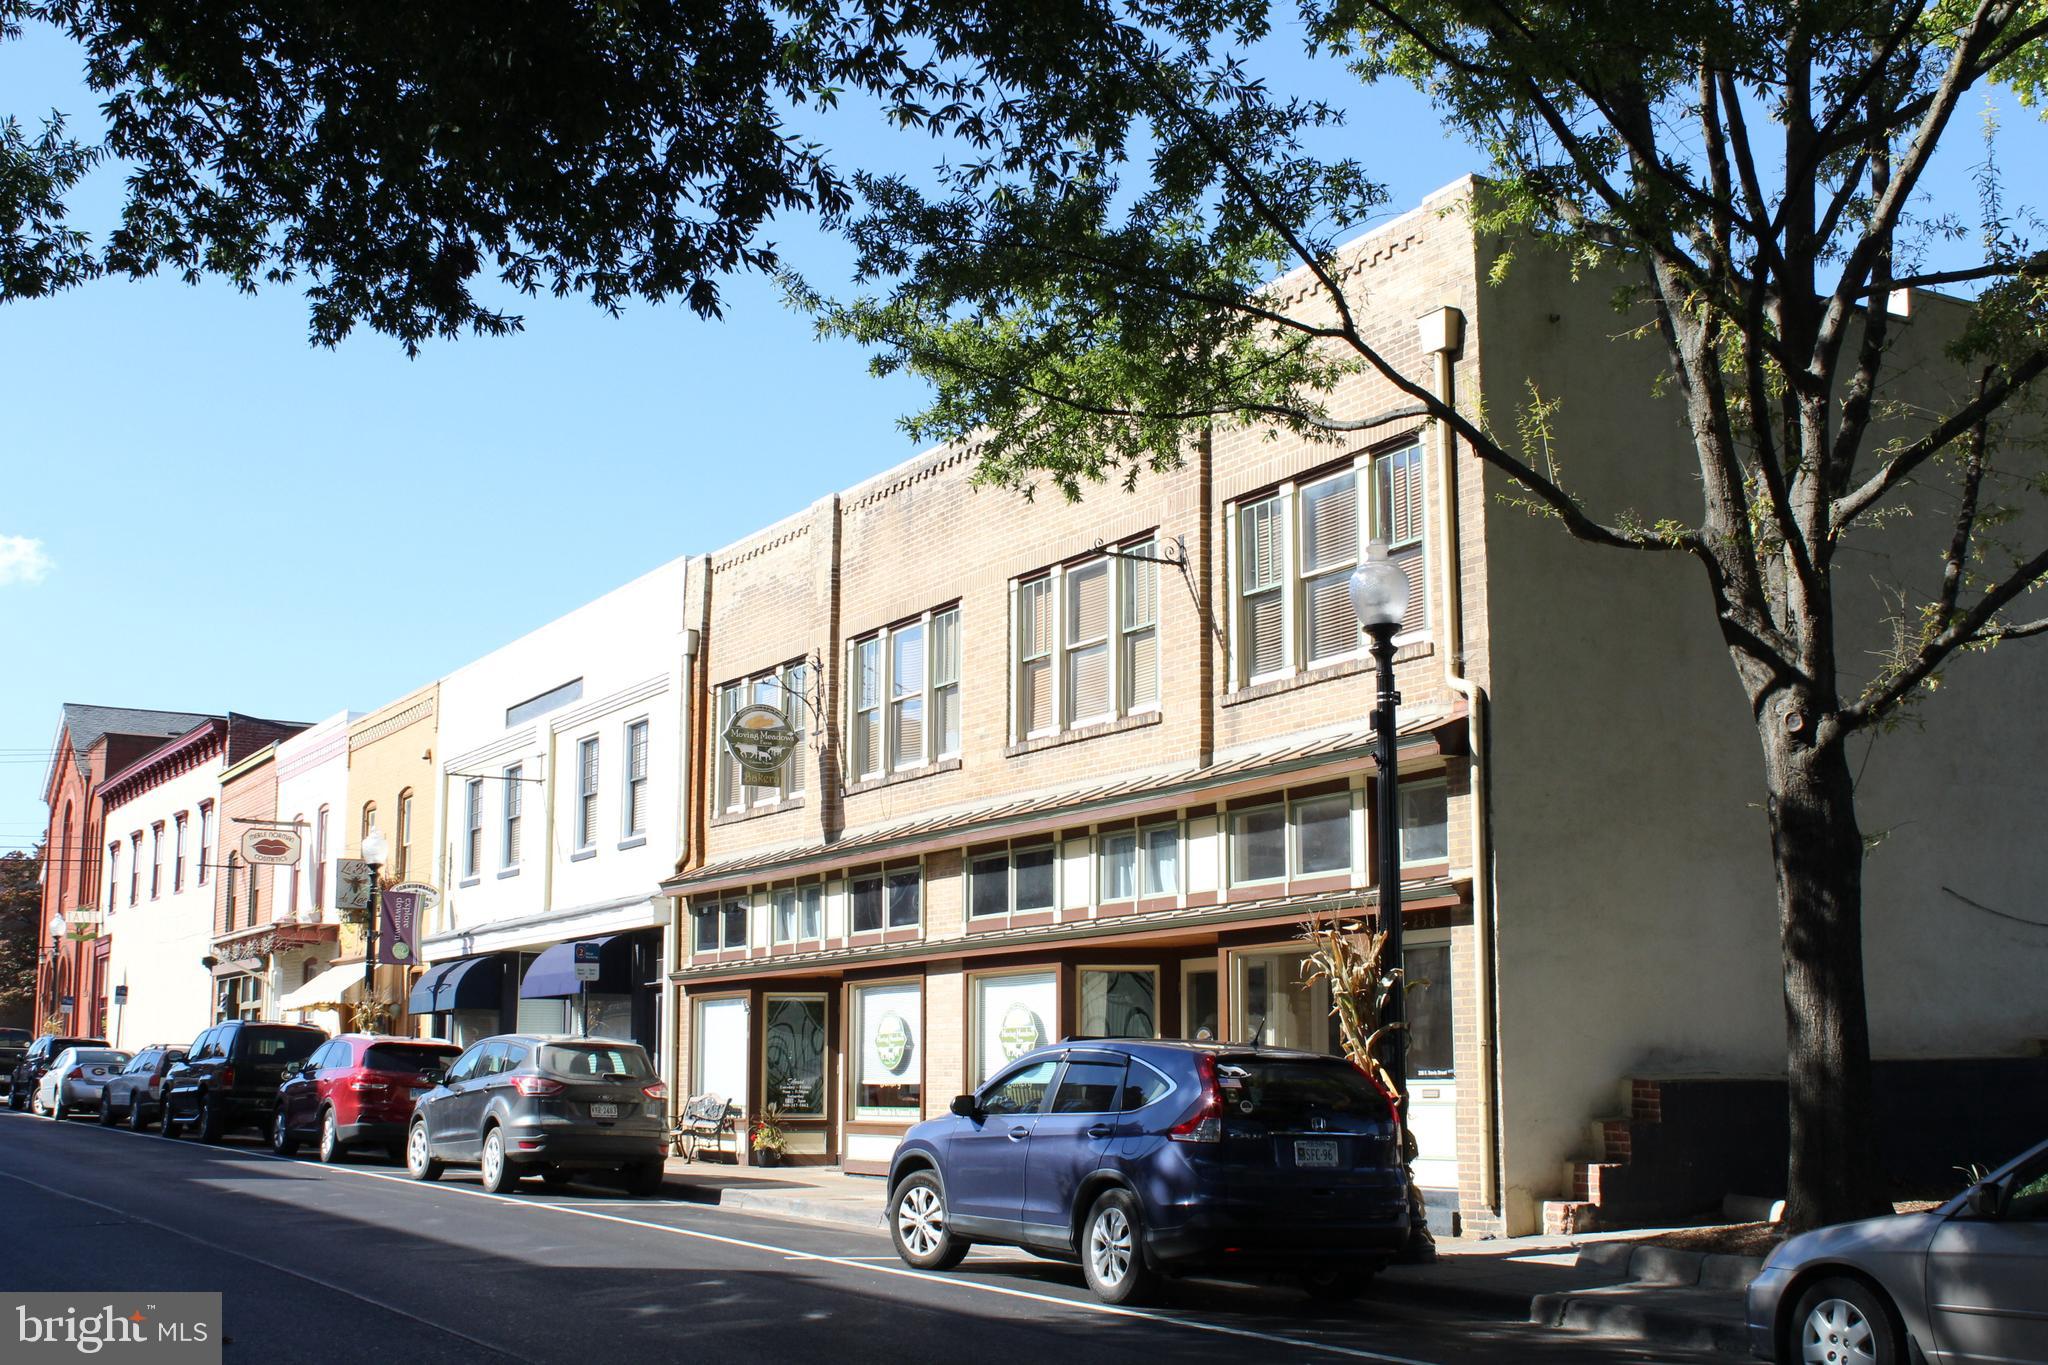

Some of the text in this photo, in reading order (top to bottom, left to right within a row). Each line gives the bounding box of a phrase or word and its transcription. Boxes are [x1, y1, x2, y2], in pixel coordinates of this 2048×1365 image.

[731, 729, 794, 742] Moving Meadows
[745, 771, 780, 784] Bakery
[249, 831, 294, 843] MERLE NORMAN
[255, 854, 288, 862] COSMETICS
[394, 897, 404, 941] downtown
[403, 897, 412, 929] explore
